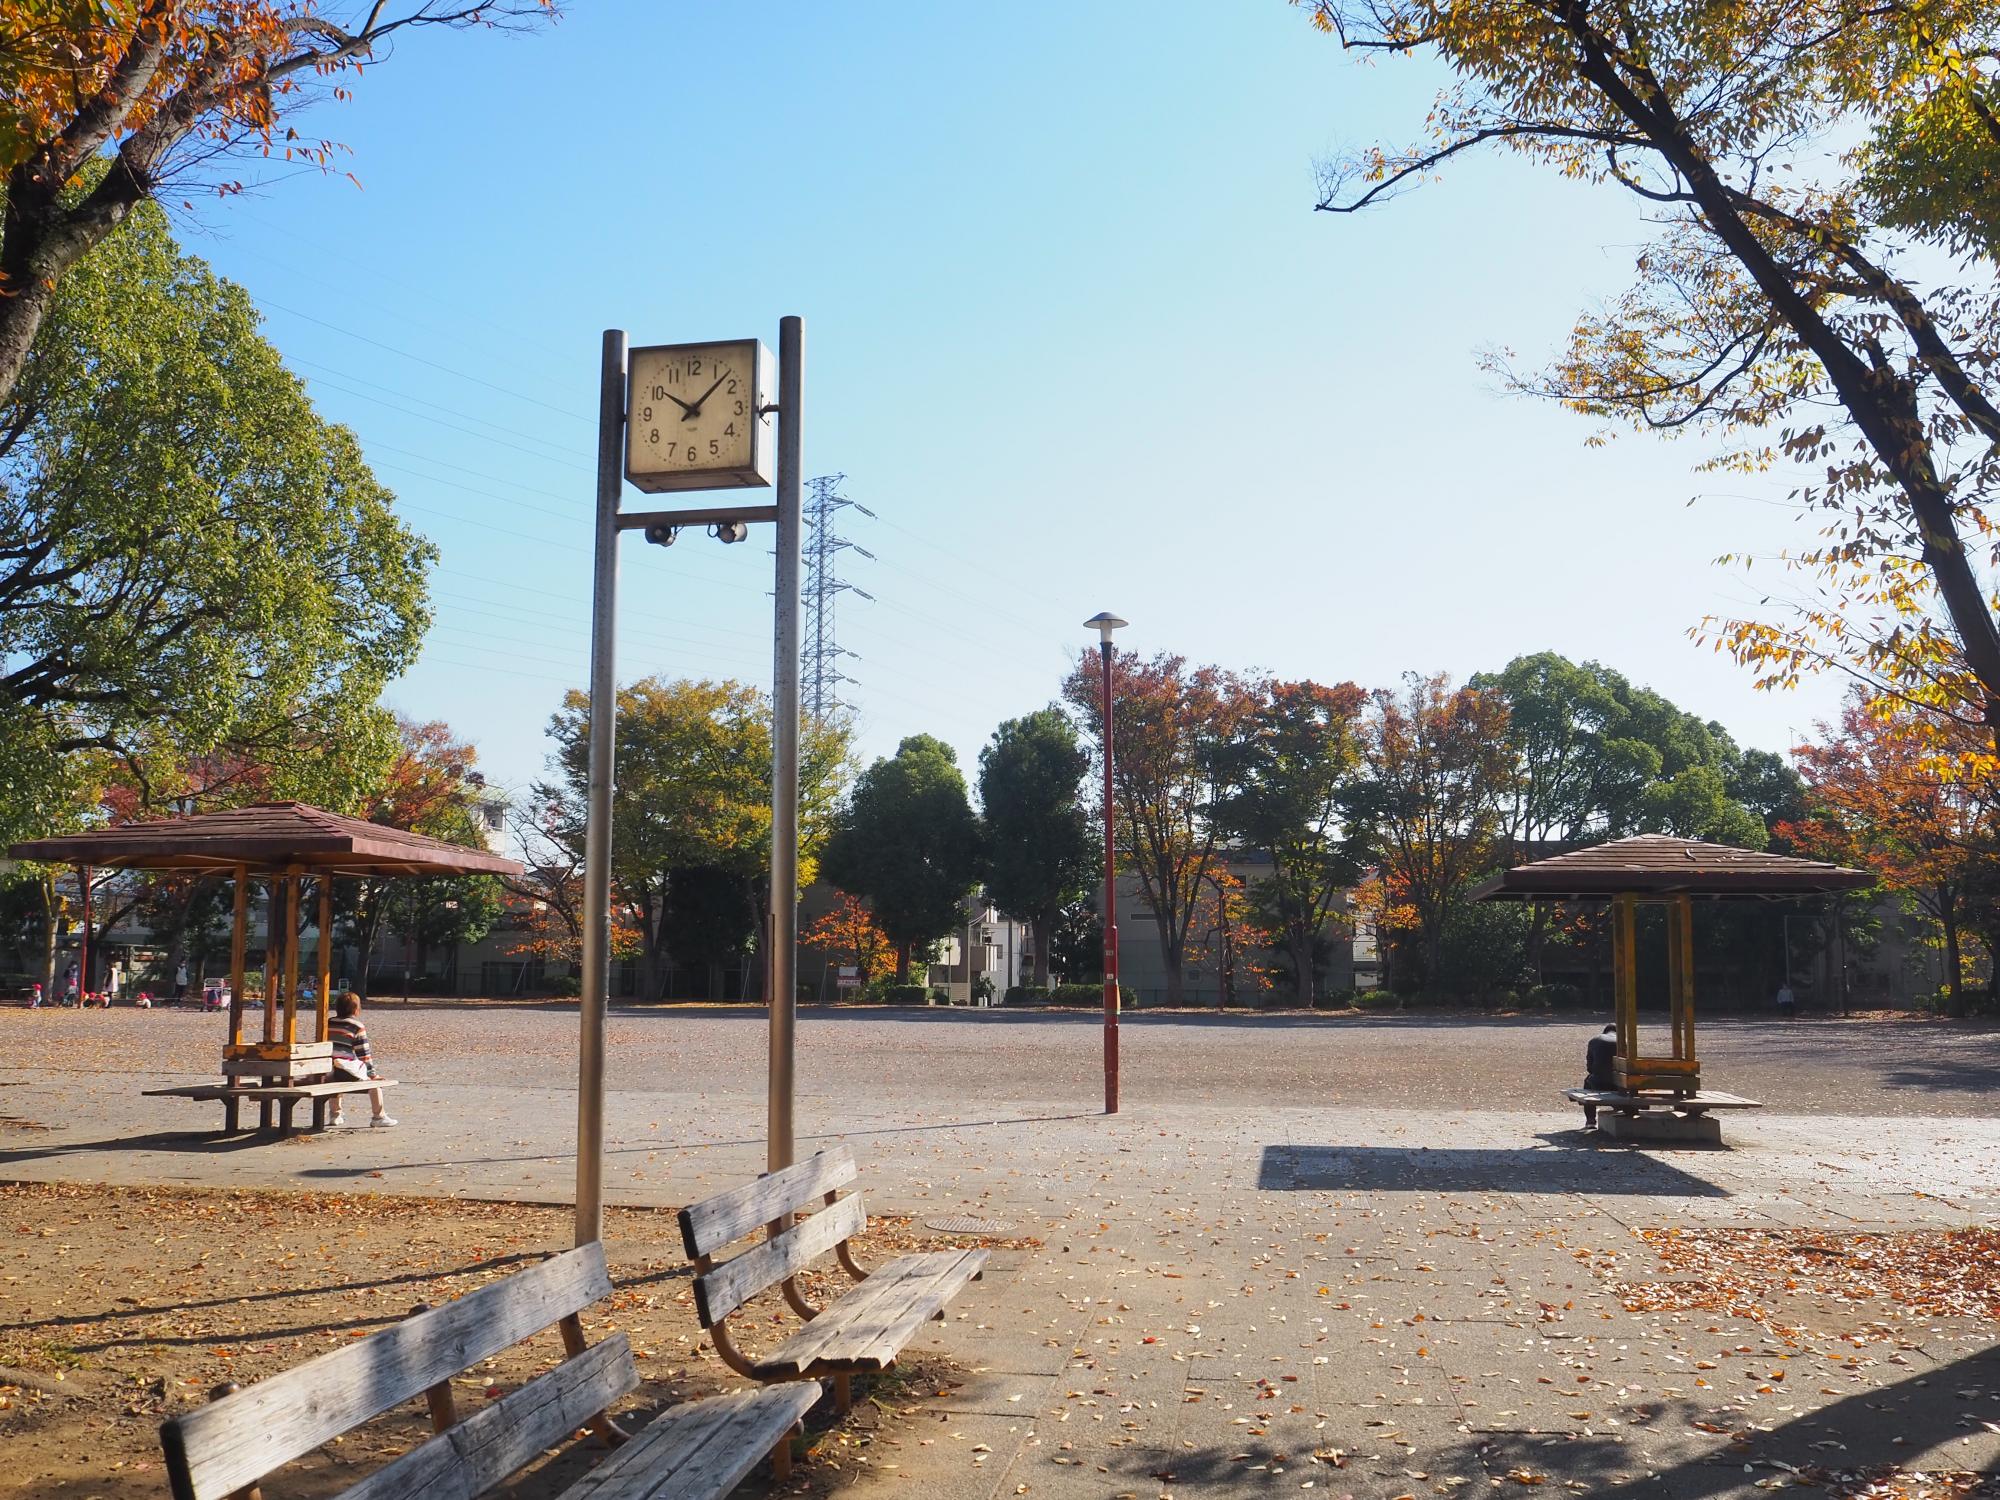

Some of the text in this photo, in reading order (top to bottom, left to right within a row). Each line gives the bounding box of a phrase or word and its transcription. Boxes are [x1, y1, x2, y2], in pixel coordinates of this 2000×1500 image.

[669, 368, 679, 384] 11
[687, 360, 702, 376] 12
[651, 385, 664, 401] 10
[727, 379, 737, 395] 2
[643, 406, 652, 422] 9
[733, 400, 744, 416] 3
[649, 428, 660, 444] 8
[724, 422, 735, 437] 4
[667, 442, 677, 457] 7
[687, 446, 697, 462] 6
[709, 439, 719, 455] 5
